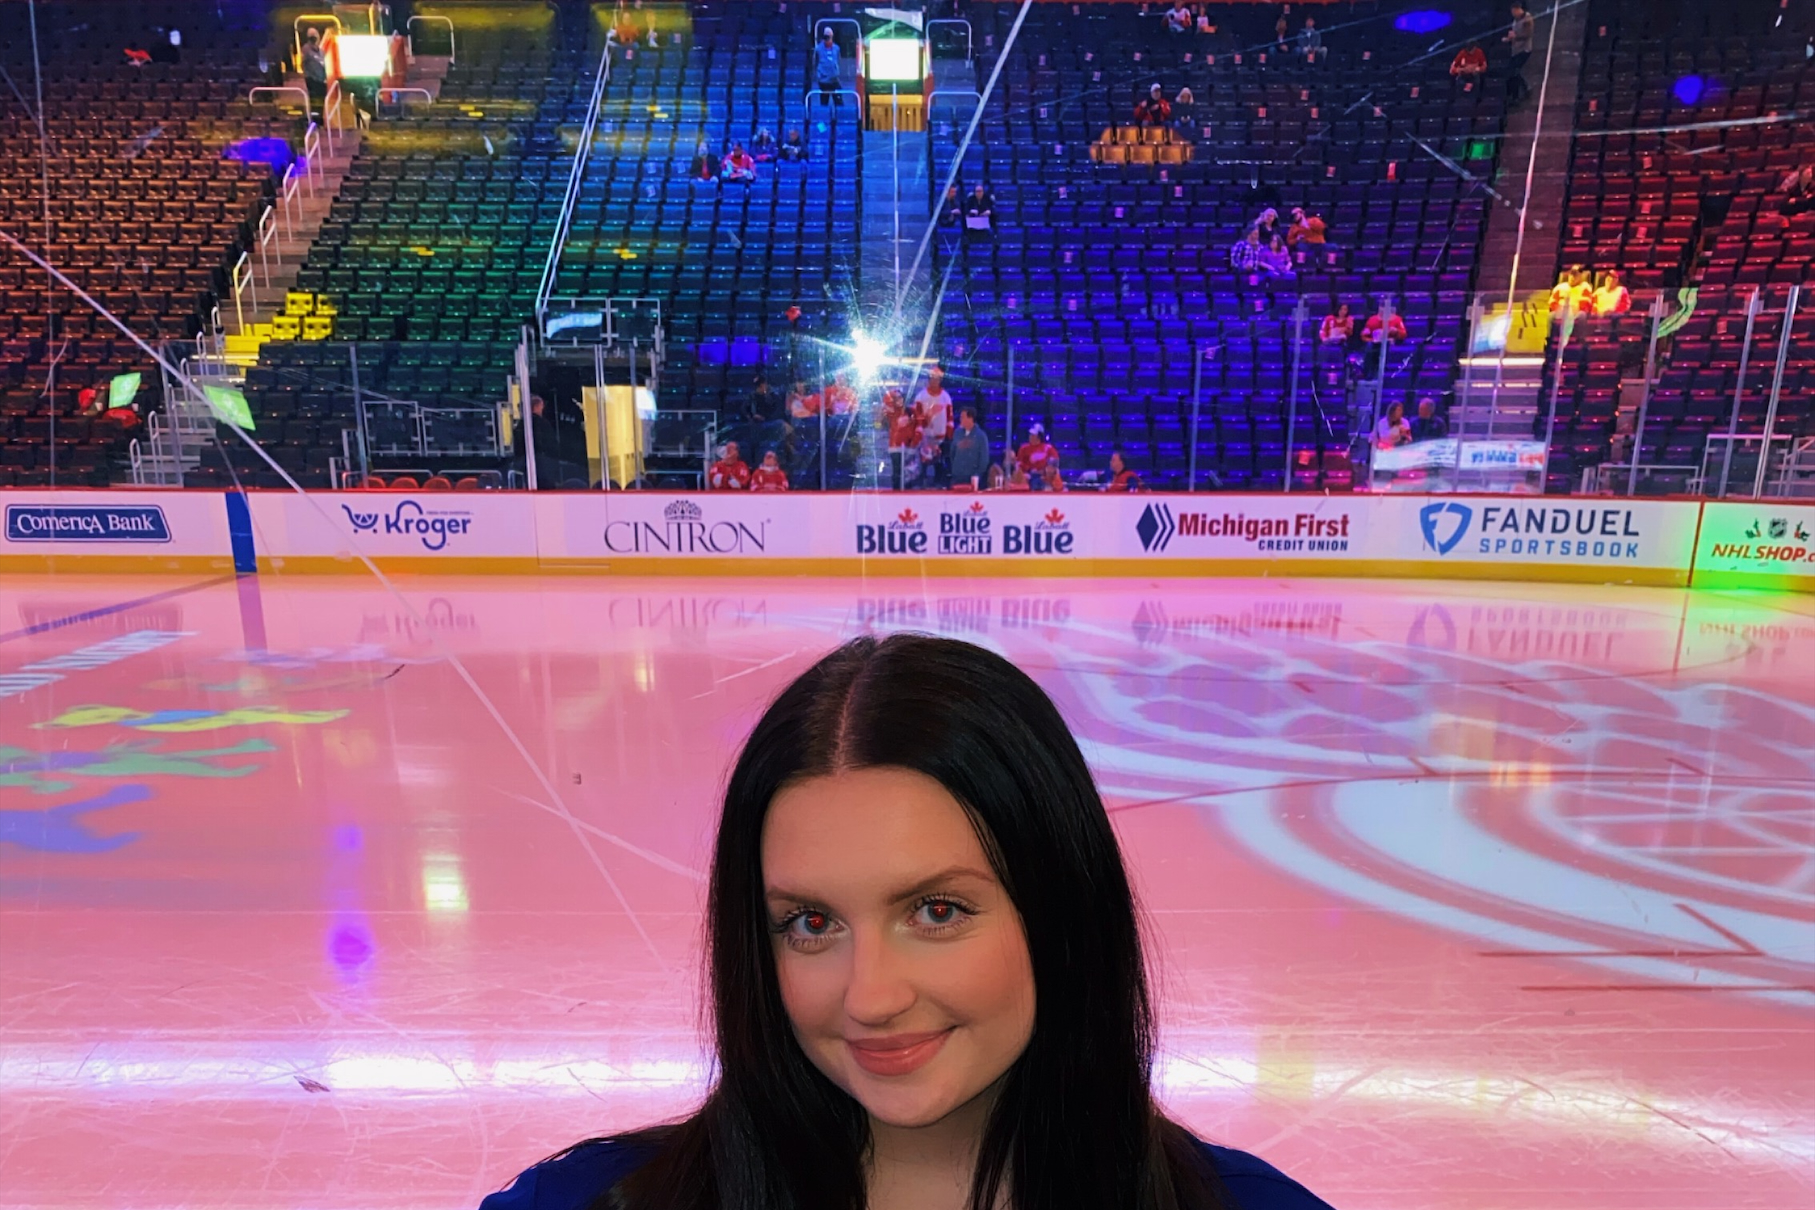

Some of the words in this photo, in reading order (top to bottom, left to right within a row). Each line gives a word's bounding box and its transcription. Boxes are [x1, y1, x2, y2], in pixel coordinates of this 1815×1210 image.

[107, 514, 156, 532] Bank
[385, 500, 471, 550] Kroger
[939, 512, 991, 534] Blue
[1178, 513, 1289, 541] Michigan
[1294, 513, 1349, 537] First
[1481, 507, 1640, 537] FANDUEL
[604, 520, 765, 553] CINTRON
[856, 525, 928, 554] Blue
[938, 535, 992, 554] LIGHT
[1003, 525, 1074, 554] Blue
[1258, 539, 1303, 551] CREDIT
[1308, 539, 1349, 551] UNION
[1478, 538, 1639, 558] SPORTSBOOK
